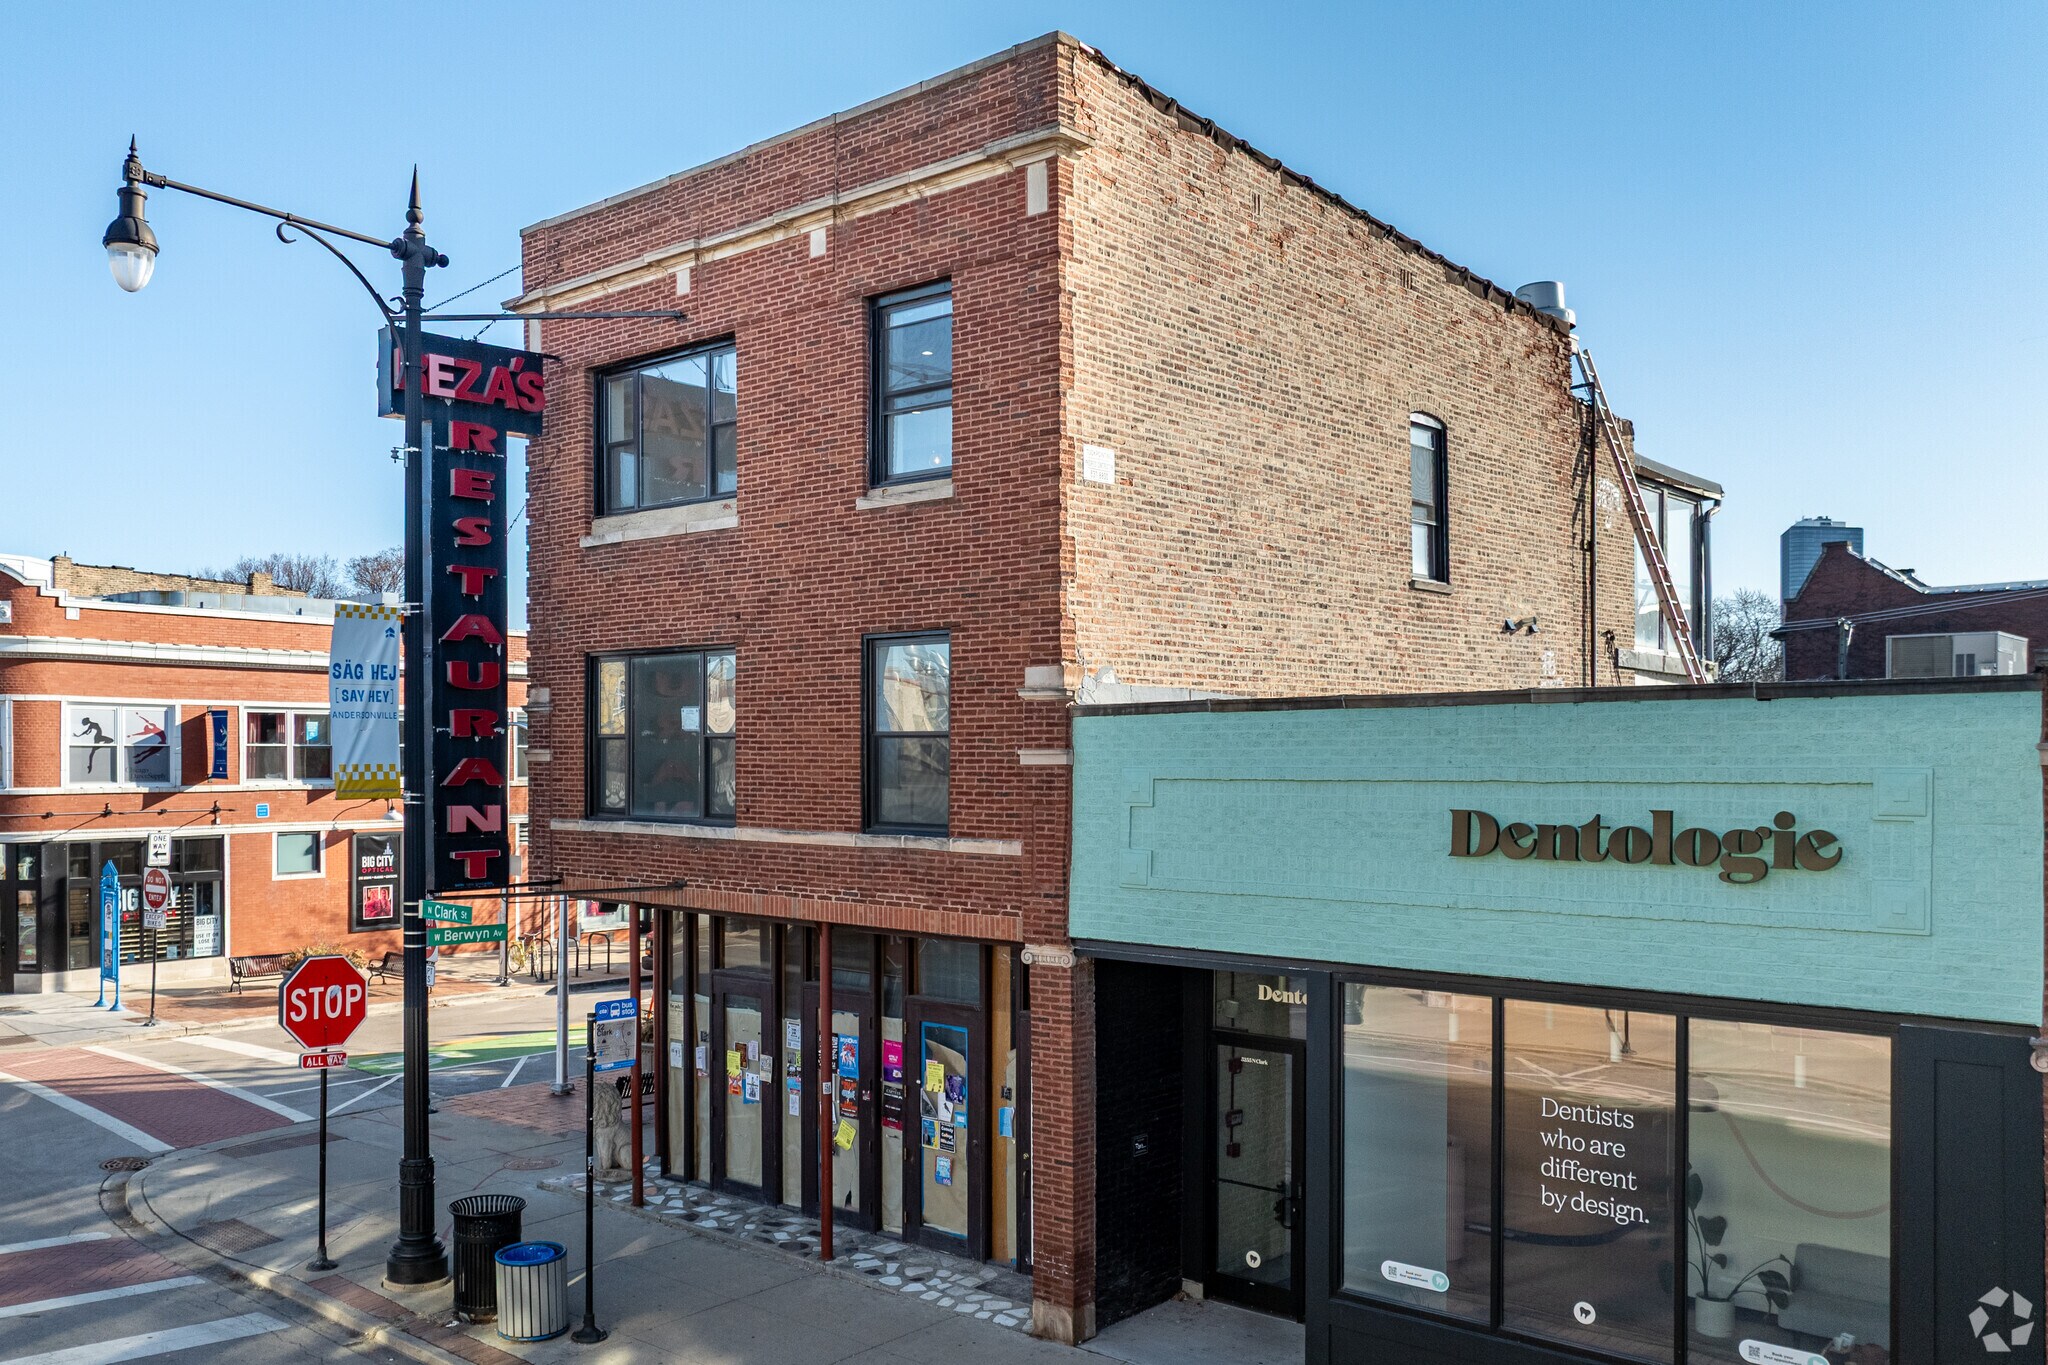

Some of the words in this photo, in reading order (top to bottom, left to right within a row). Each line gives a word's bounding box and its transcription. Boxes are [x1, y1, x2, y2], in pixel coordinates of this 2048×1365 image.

[438, 420, 506, 879] RESTAURANT
[332, 659, 364, 680] SÄG
[371, 664, 397, 681] HEJ
[332, 711, 398, 720] ANDERSONVILLE
[1448, 808, 1843, 885] Dentologie
[361, 856, 376, 868] BIG
[376, 855, 394, 868] CITY
[119, 888, 139, 912] IG
[148, 893, 163, 902] ENTER
[146, 913, 164, 921] EXCEPT
[427, 906, 433, 914] N
[434, 904, 458, 921] Clark
[461, 911, 468, 919] St
[196, 918, 206, 926] BIG
[206, 917, 219, 925] CITY
[434, 934, 441, 942] W
[444, 930, 490, 942] Berwyn
[289, 983, 363, 1022] STOP
[621, 1008, 635, 1016] stop
[596, 1023, 605, 1031] 22
[596, 1029, 613, 1037] Clark
[306, 1056, 324, 1068] ALL
[326, 1054, 344, 1066] WAY
[1541, 1097, 1635, 1130] Dentists
[1540, 1128, 1586, 1152] who
[1589, 1139, 1626, 1158] are
[1540, 1156, 1638, 1191] different
[1541, 1184, 1568, 1213] by
[1570, 1191, 1650, 1226] design.
